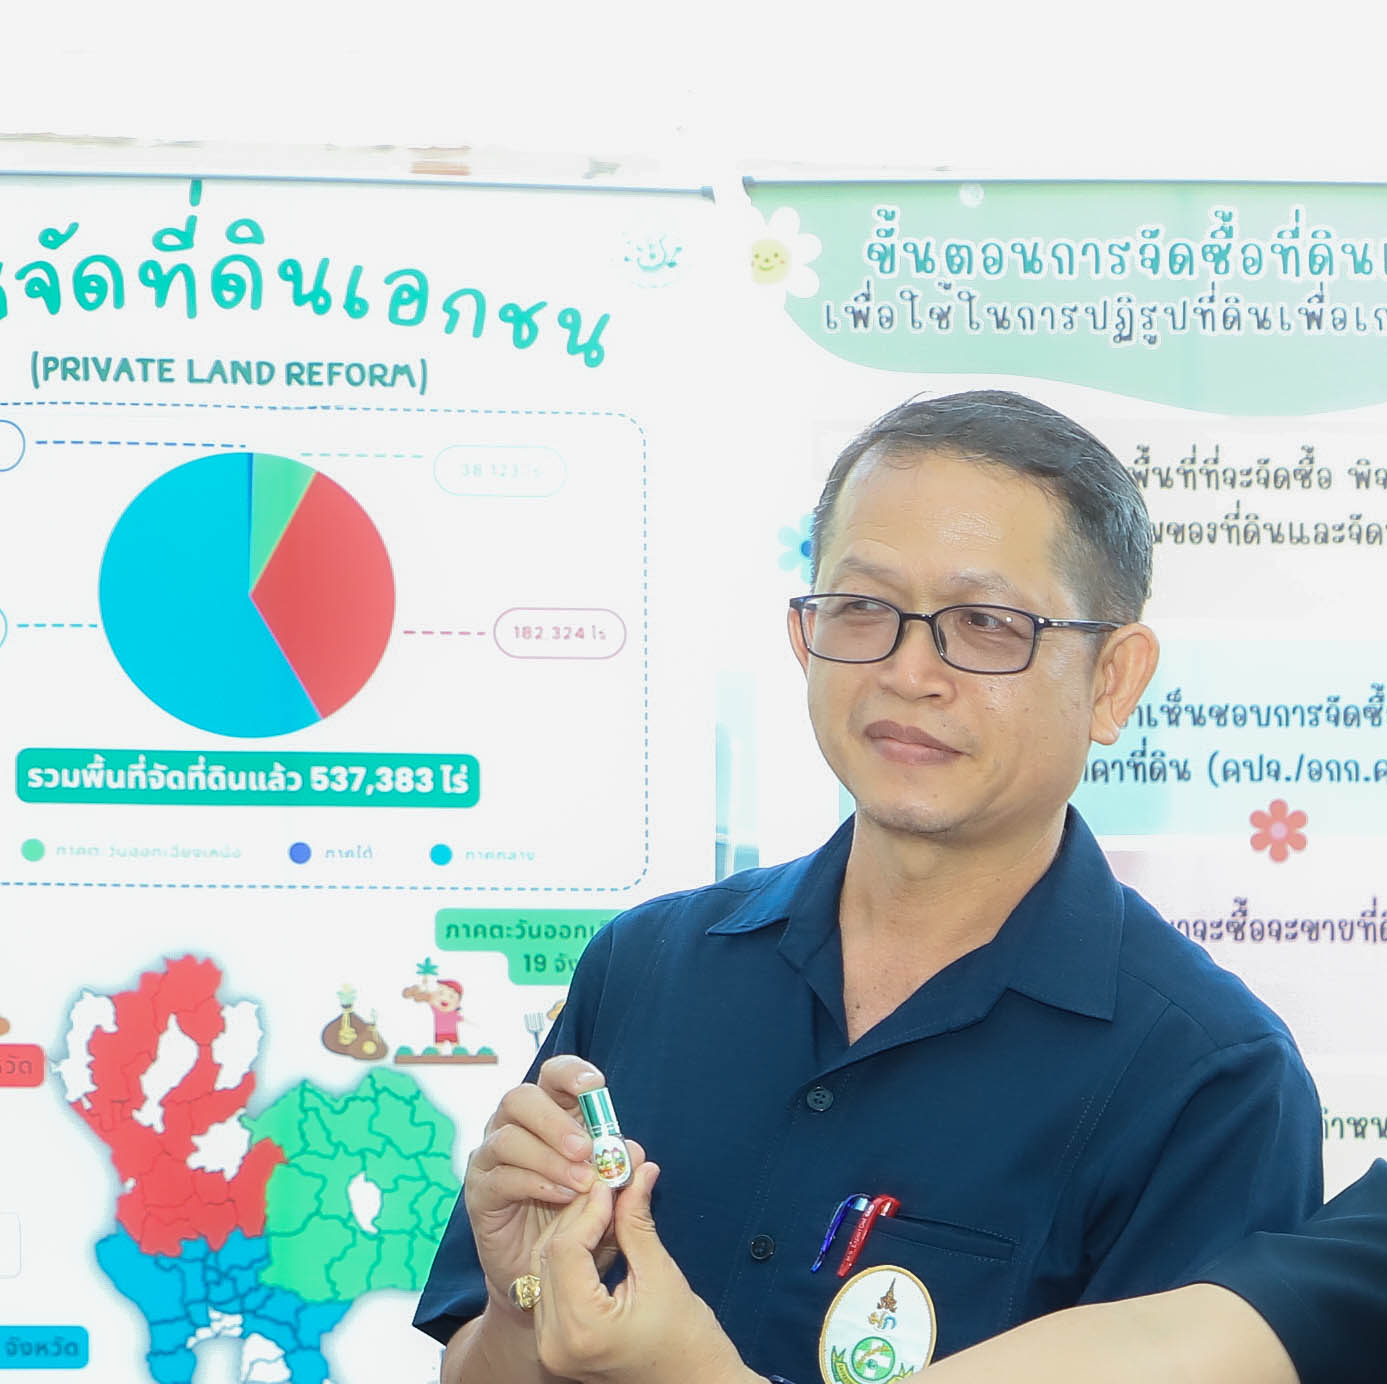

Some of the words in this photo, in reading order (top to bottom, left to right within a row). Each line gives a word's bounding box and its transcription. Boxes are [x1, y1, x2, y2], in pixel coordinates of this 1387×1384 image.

[31, 351, 175, 388] (PRIVATE
[187, 357, 275, 385] LAND
[285, 358, 430, 395] REFORM)
[310, 763, 435, 796] 537,383
[439, 763, 469, 794] ไร่
[523, 954, 547, 973] 19
